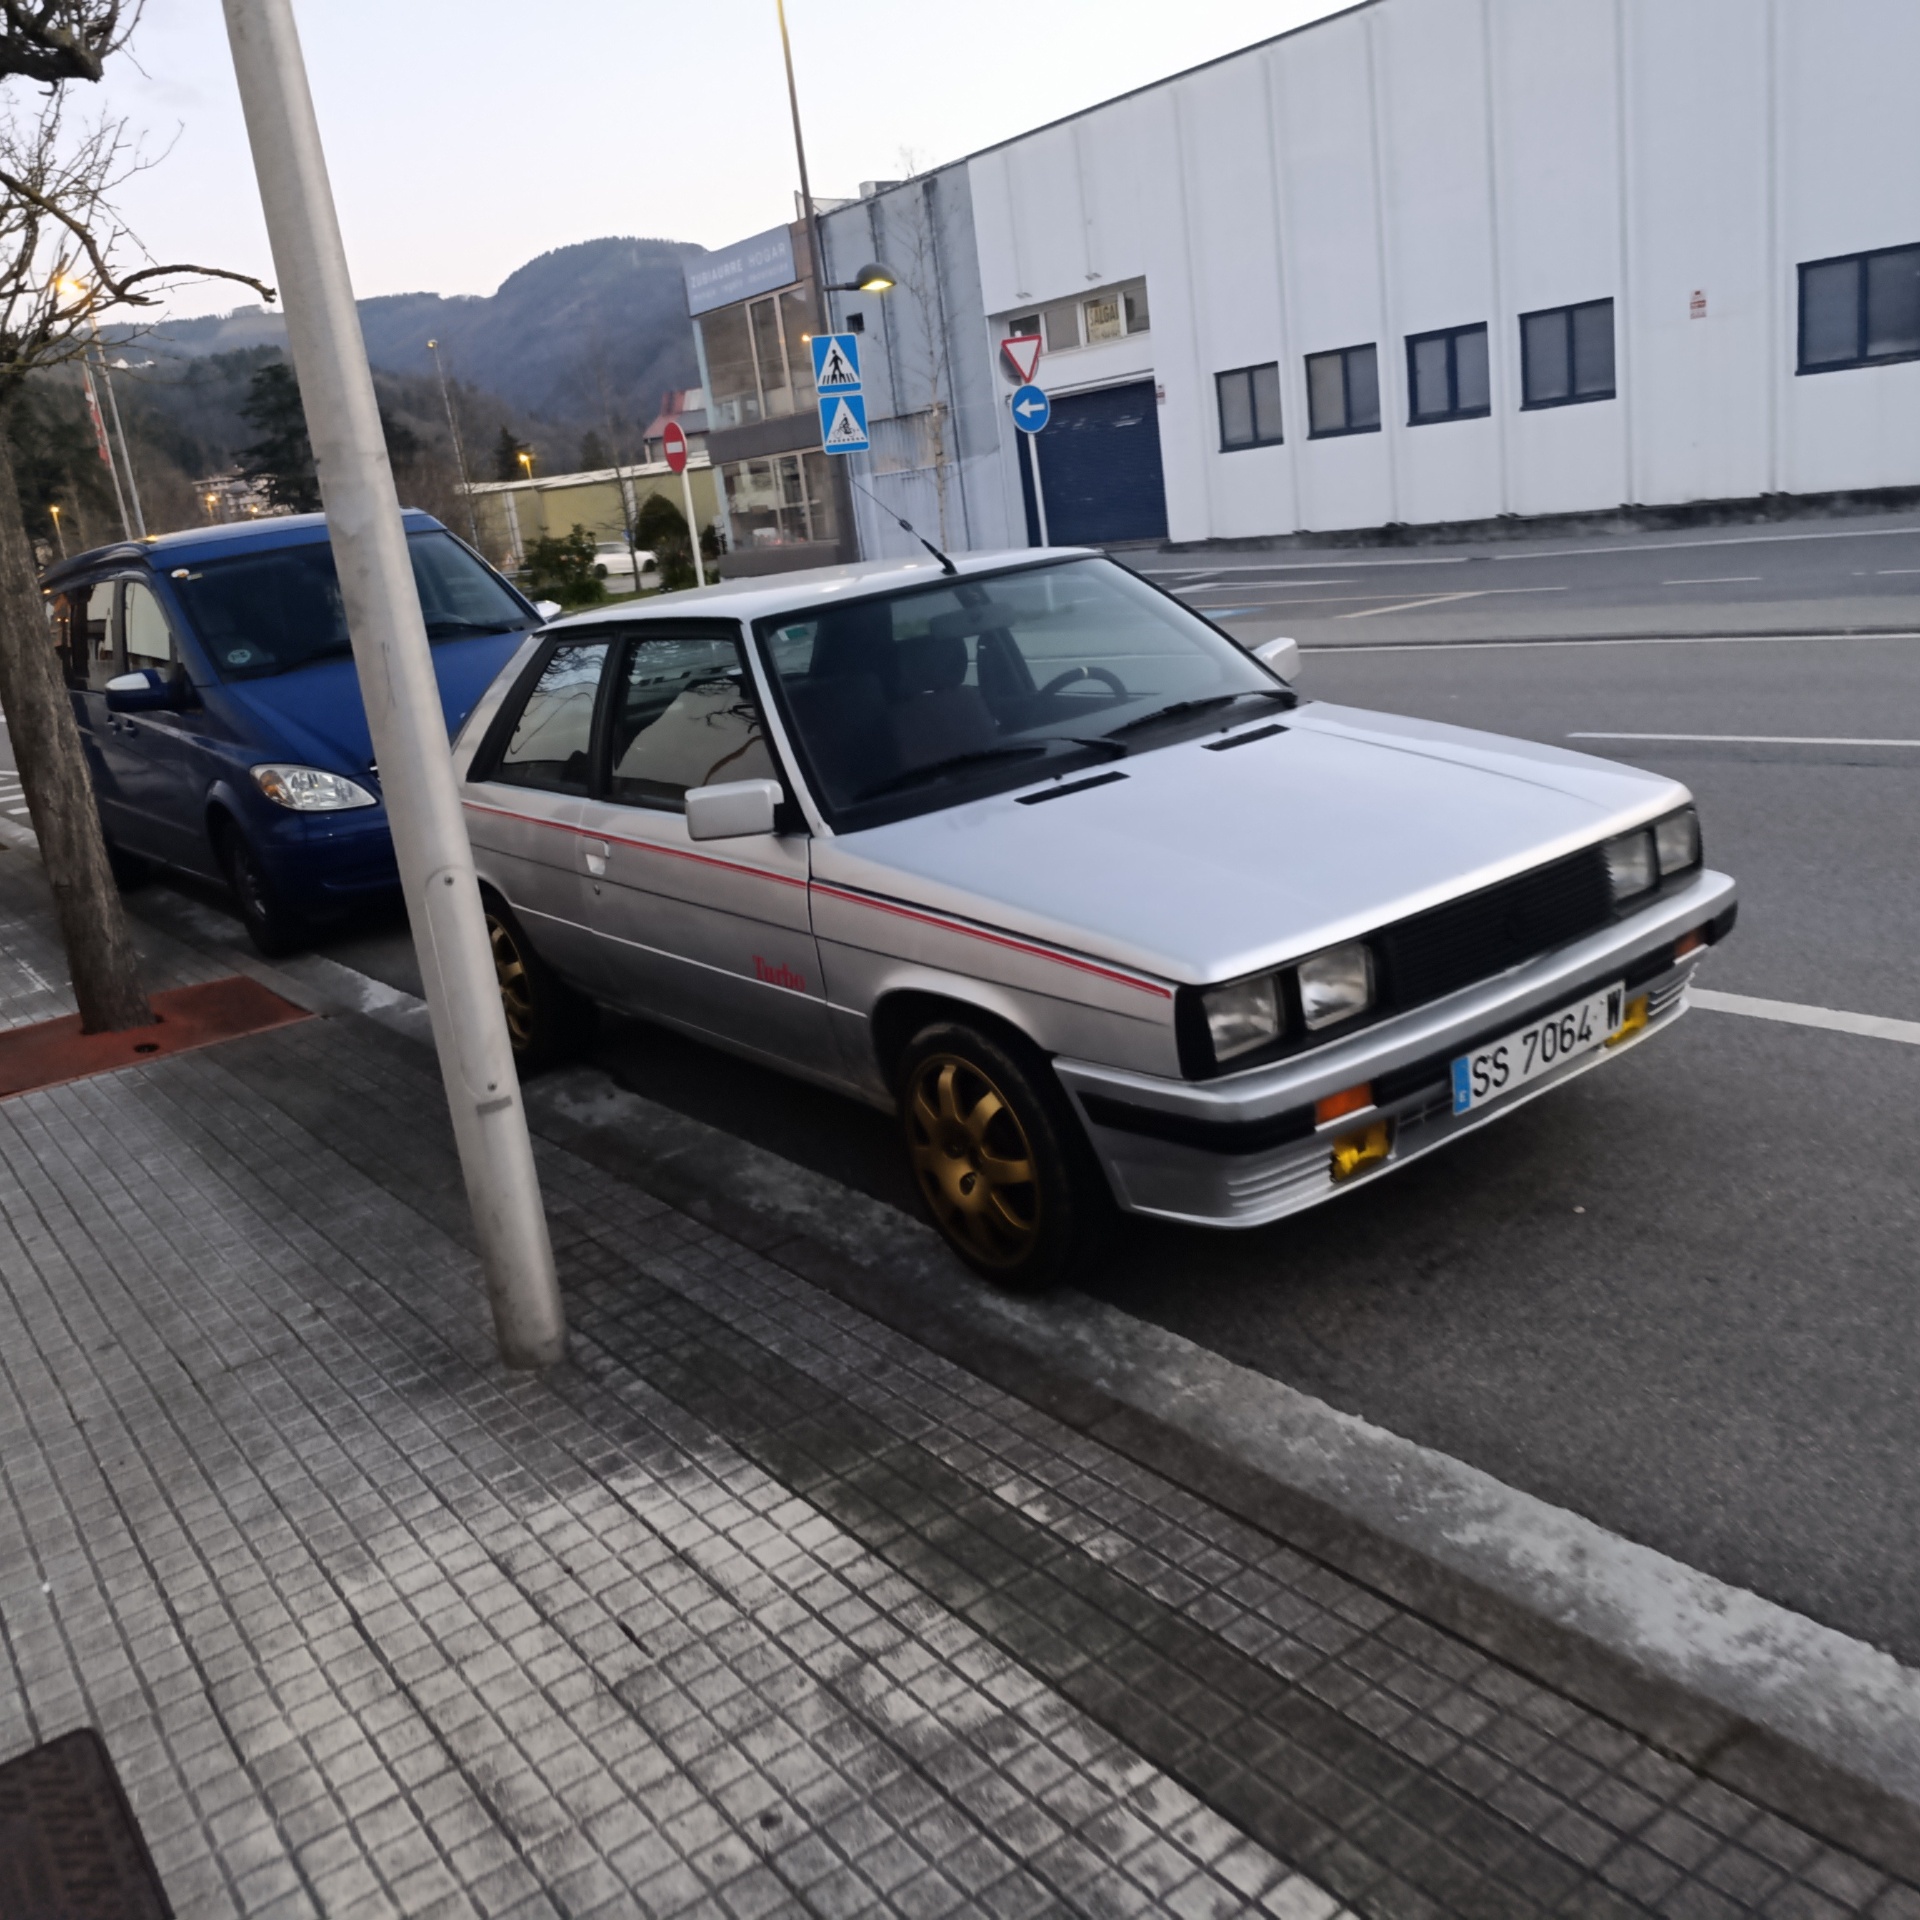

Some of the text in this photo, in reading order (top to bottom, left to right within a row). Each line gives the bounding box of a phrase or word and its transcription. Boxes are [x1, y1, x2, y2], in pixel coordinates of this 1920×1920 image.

[690, 259, 743, 288] ZUBIAURRE
[747, 242, 786, 268] HOGAR
[752, 955, 806, 992] Turbo
[1472, 988, 1622, 1098] SS 7064 W
